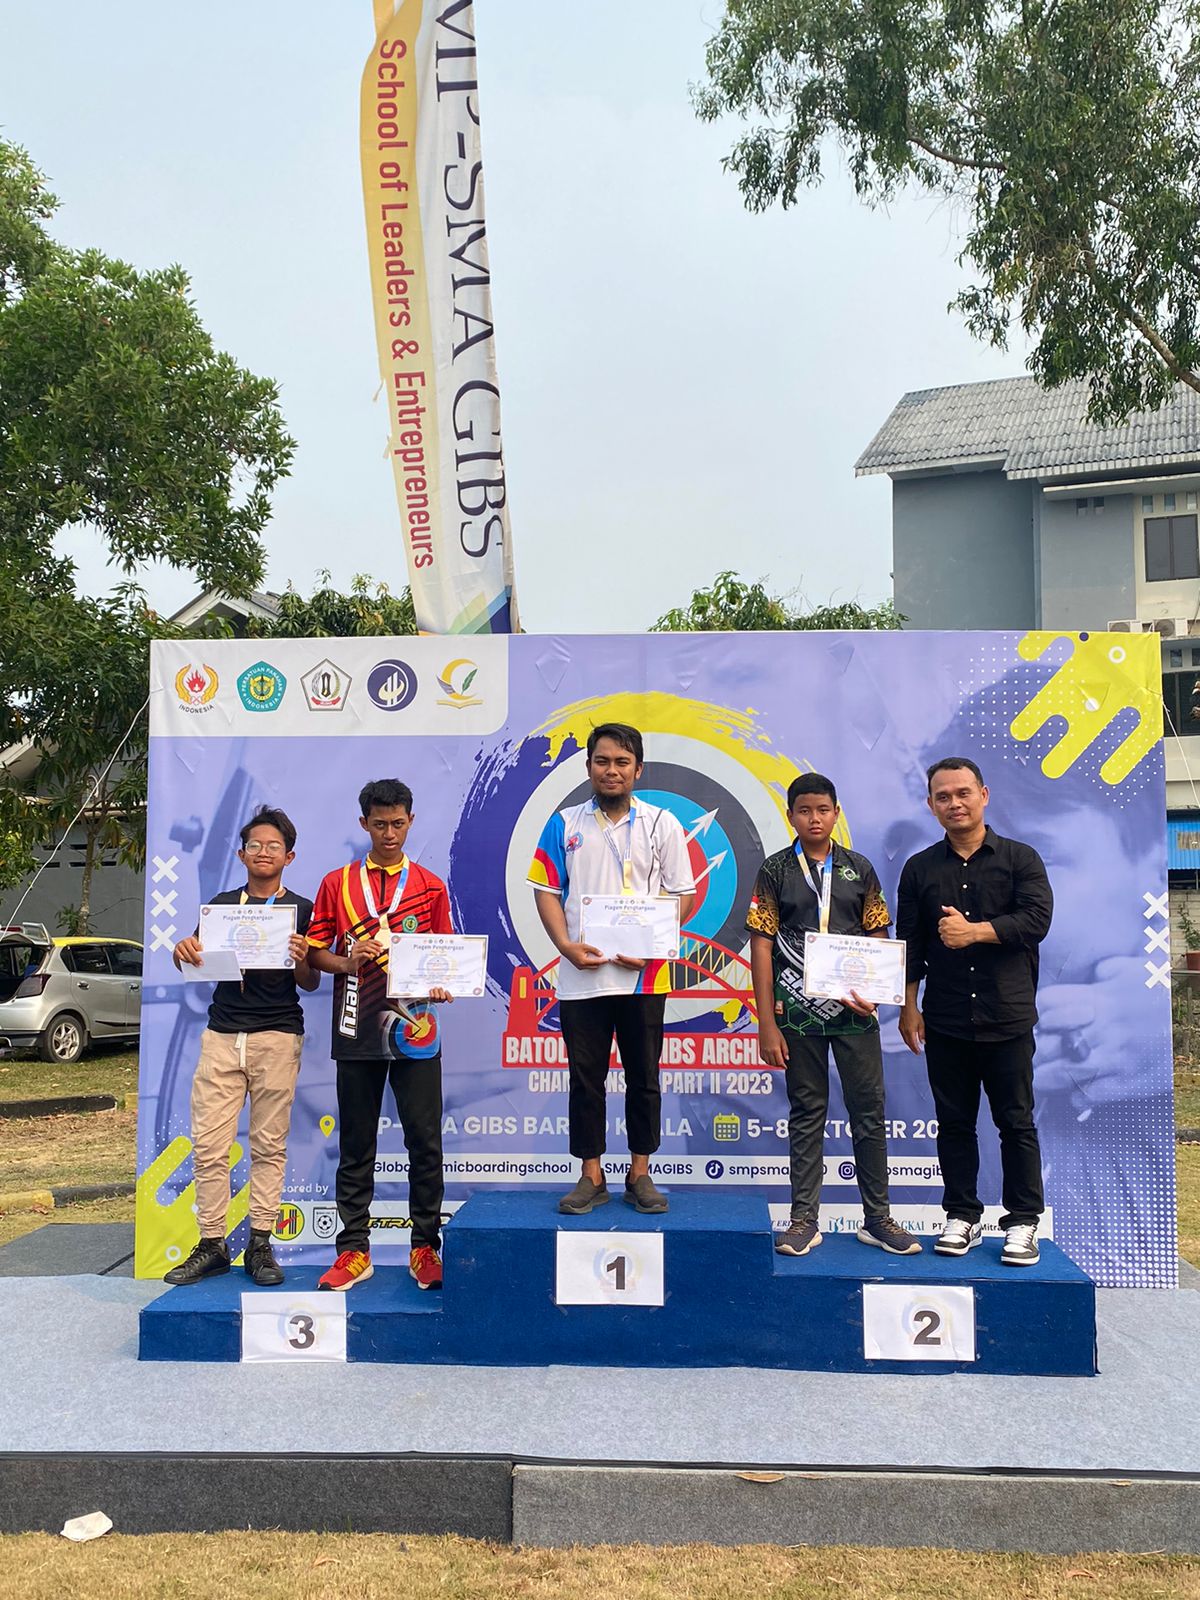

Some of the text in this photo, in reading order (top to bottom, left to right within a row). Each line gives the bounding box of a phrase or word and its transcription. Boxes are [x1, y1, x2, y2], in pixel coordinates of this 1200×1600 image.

[377, 39, 434, 569] School of Leaders & Entrepreneurs
[452, 380, 506, 558] GIBS
[179, 704, 215, 714] INDONESIA
[246, 697, 280, 709] INDONESIA
[780, 980, 811, 1008] archery
[811, 1006, 831, 1021] club
[506, 1036, 568, 1064] BATOL
[660, 1038, 696, 1065] IBS
[662, 1072, 704, 1094] PART
[726, 1072, 773, 1095] 2023
[464, 1116, 518, 1135] GIBS
[747, 1118, 789, 1138] 5-8
[912, 1119, 940, 1139] 20
[315, 1183, 329, 1196] by
[606, 1255, 626, 1290] 1
[289, 1314, 315, 1349] 3
[913, 1310, 941, 1345] 2
